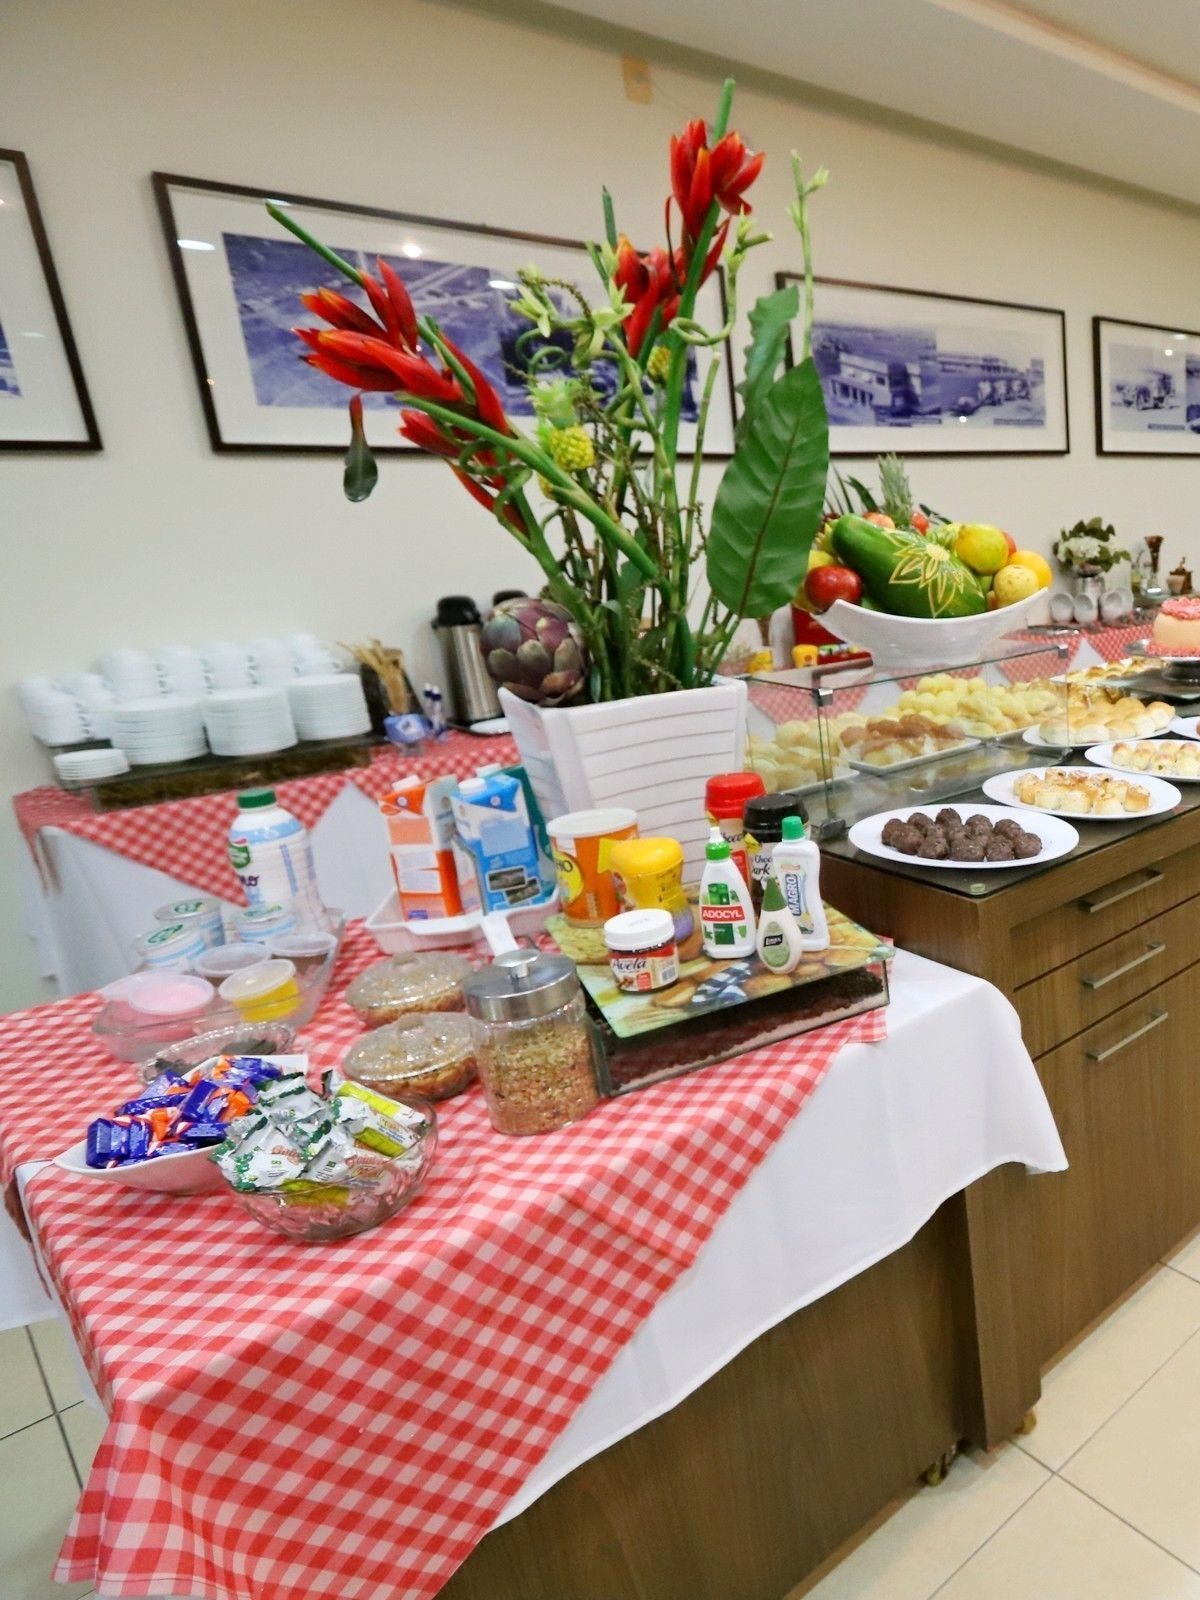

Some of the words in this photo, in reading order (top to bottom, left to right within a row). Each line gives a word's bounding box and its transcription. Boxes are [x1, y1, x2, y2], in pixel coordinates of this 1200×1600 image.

[752, 863, 771, 875] ark
[785, 875, 801, 915] MAGRO
[702, 908, 742, 919] ADOCYL
